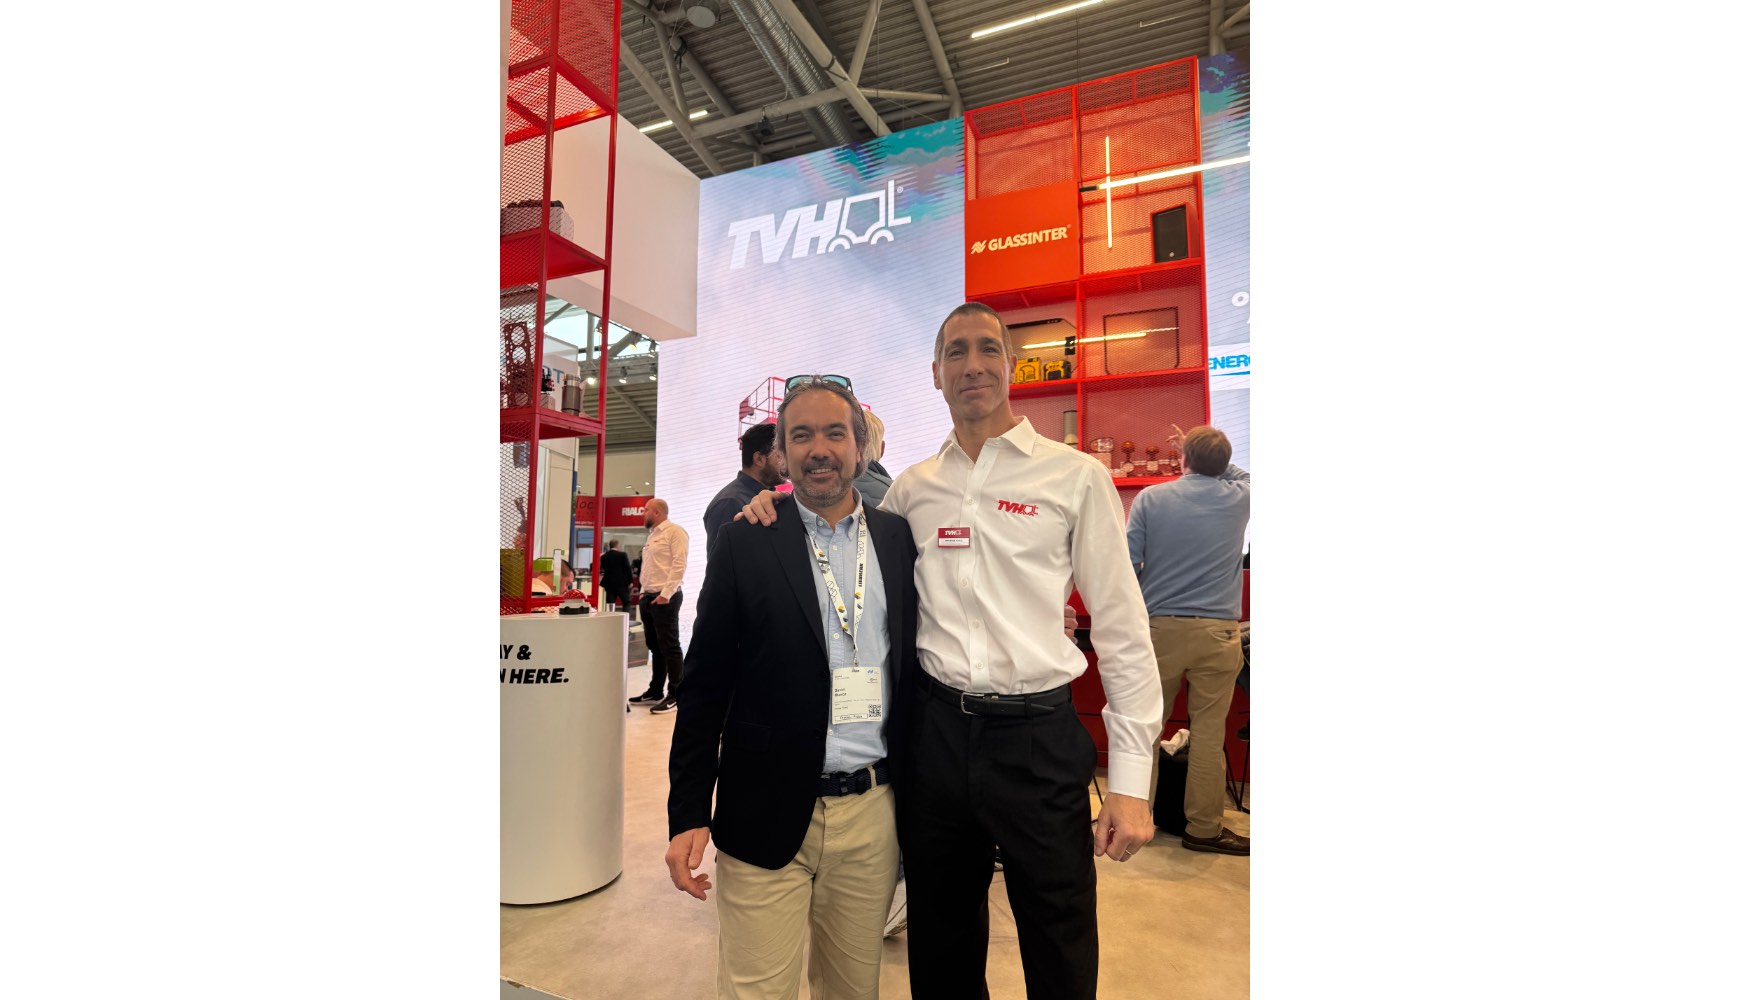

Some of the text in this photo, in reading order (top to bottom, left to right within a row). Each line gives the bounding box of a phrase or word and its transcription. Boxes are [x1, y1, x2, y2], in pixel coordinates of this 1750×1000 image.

[728, 198, 844, 270] TVH
[988, 226, 1068, 251] GLASSINTER
[1208, 354, 1250, 370] ENER
[500, 644, 532, 660] Y &
[509, 668, 569, 684] HERE.
